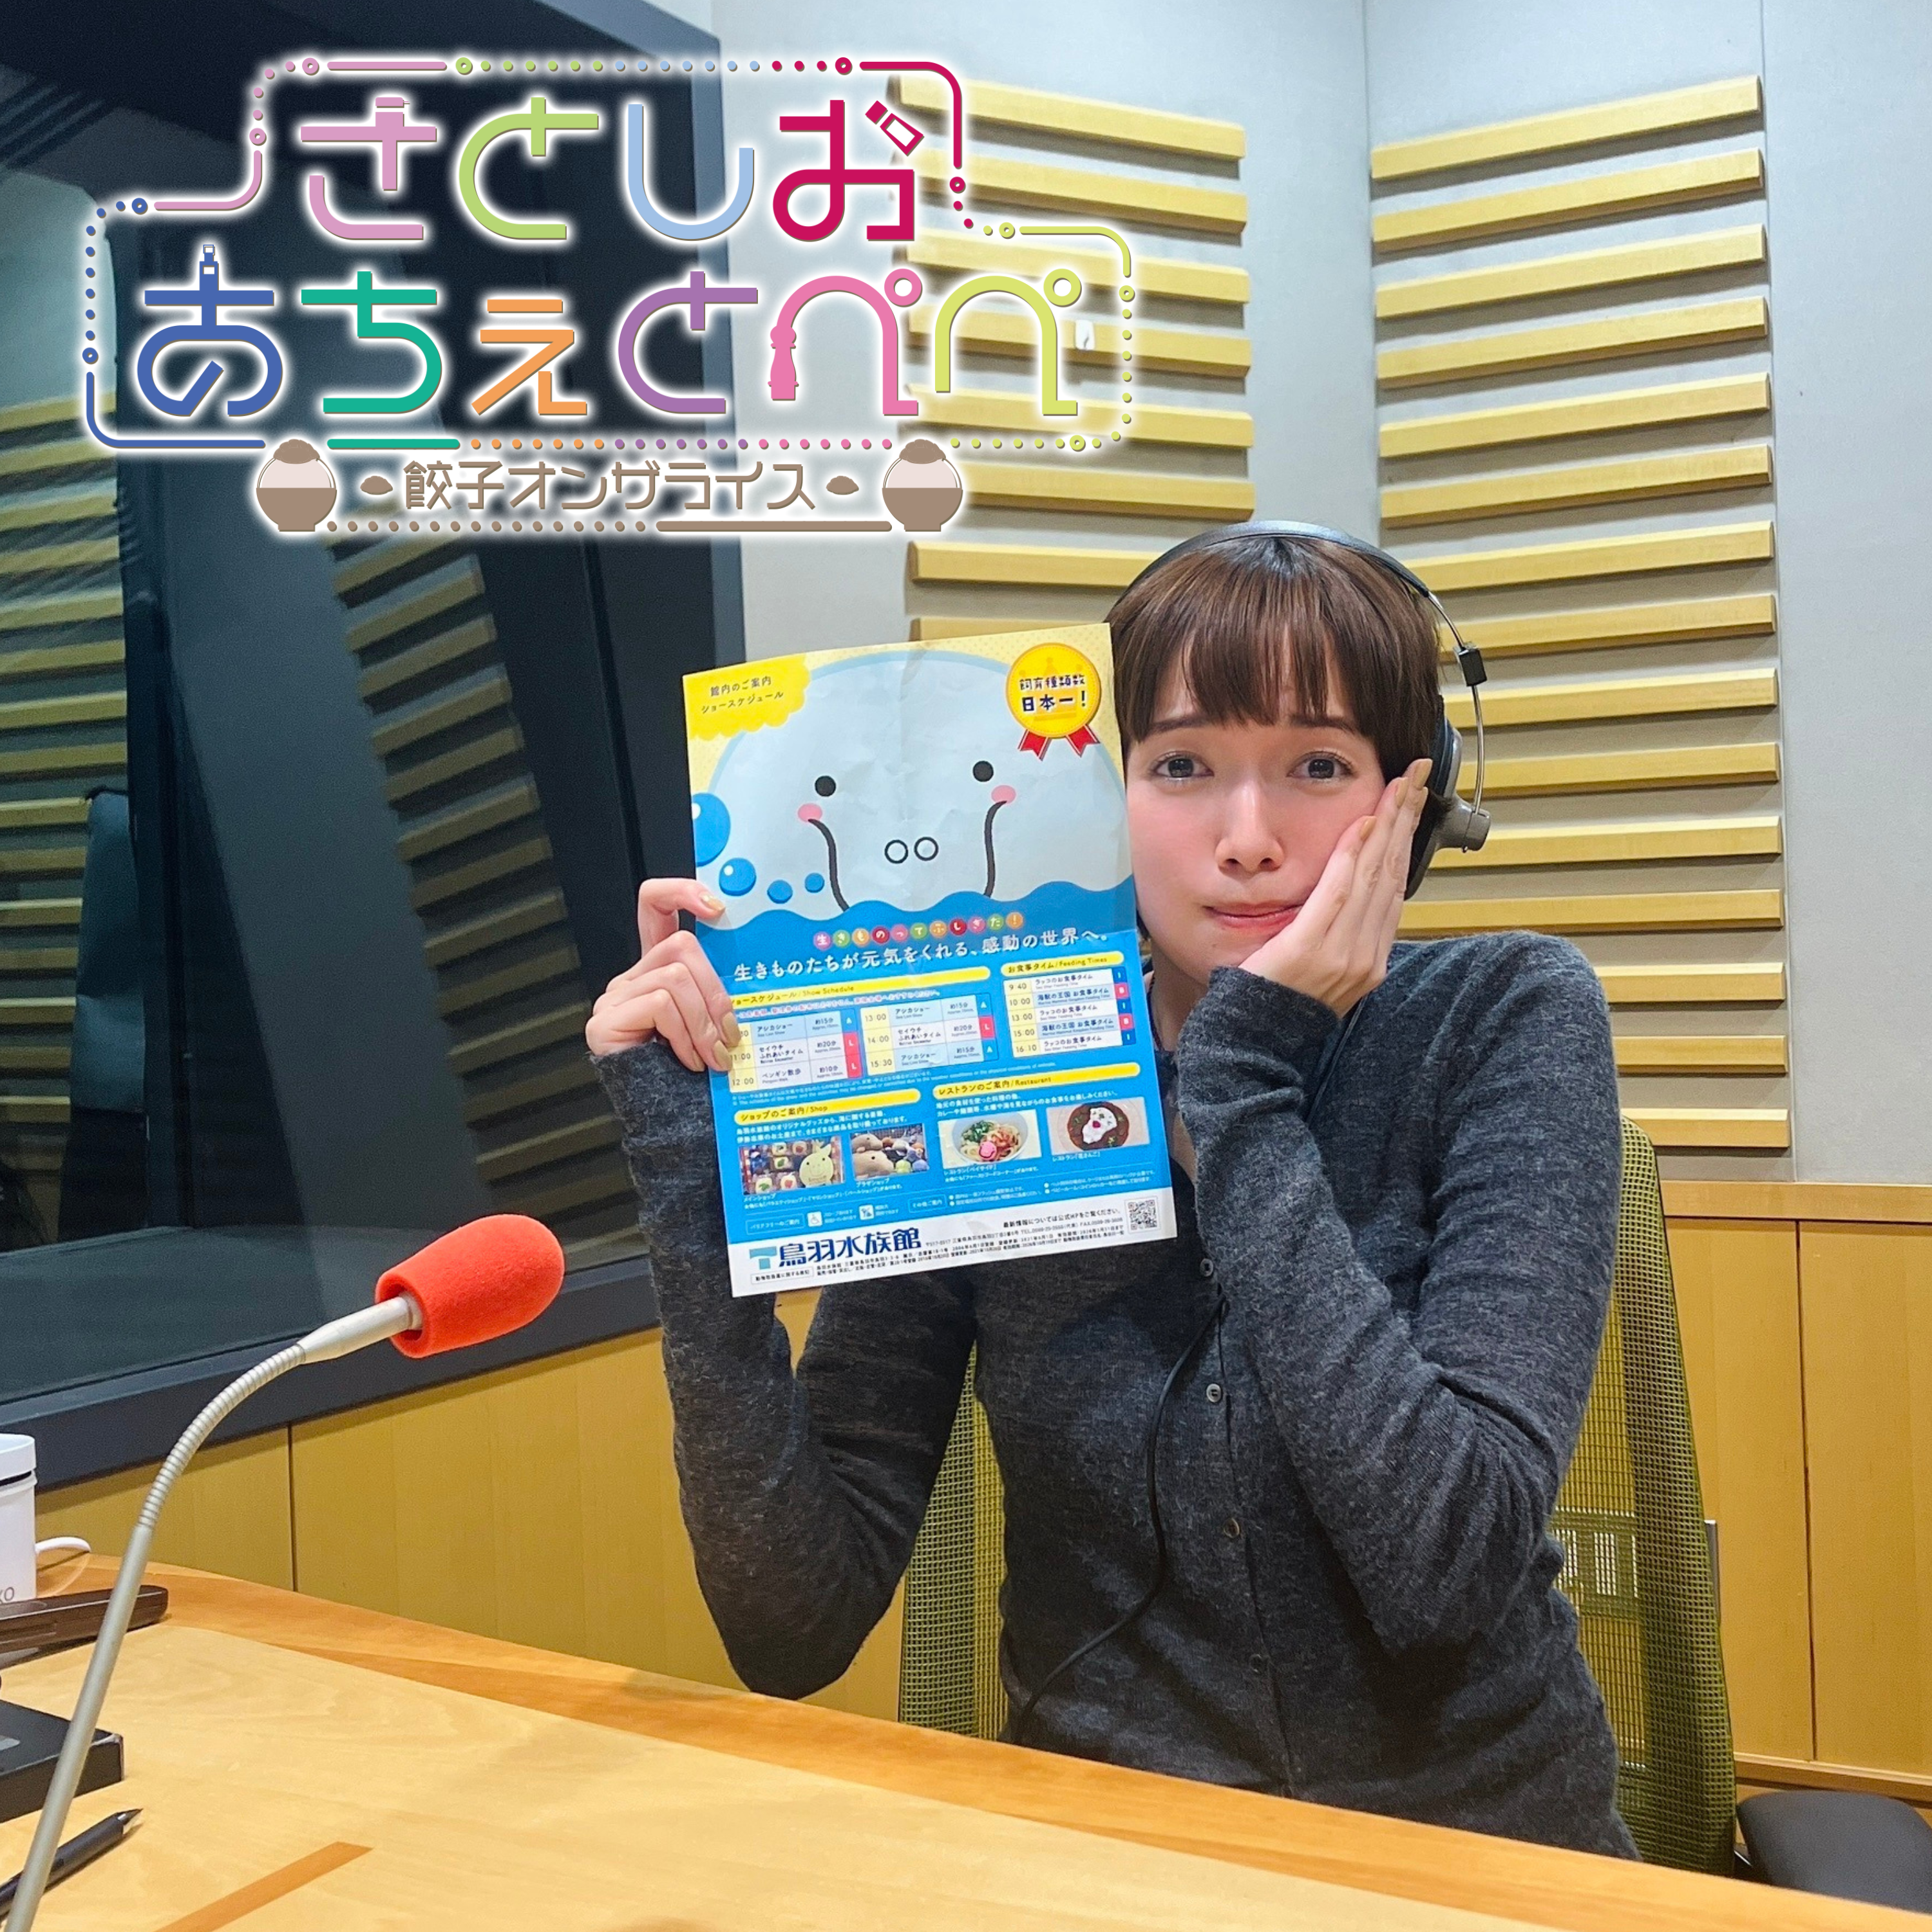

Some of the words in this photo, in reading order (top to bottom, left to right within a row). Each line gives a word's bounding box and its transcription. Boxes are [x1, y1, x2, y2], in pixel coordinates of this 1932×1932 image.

[710, 676, 772, 697] 館内のご案内
[1019, 674, 1085, 690] 飼育種類数
[701, 691, 784, 714] ショースケジュール
[734, 927, 1108, 981] 生きものたちが元気をくれる、感動の世界へ。
[1087, 956, 1107, 965] Times
[1034, 973, 1094, 986] ラッコのお食事タイム
[822, 985, 854, 995] Schedule
[1036, 990, 1071, 1001] 海獣の王国
[1072, 986, 1109, 998] お食事タイム
[895, 1005, 930, 1015] アシカショー
[1039, 1004, 1097, 1017] ラッコのお食事タイム
[814, 1016, 834, 1025] 約15分
[983, 1022, 990, 1030] L
[1041, 1021, 1075, 1033] 海獣の王国
[1077, 1017, 1114, 1028] お食事タイム
[756, 1022, 793, 1033] アシカショー
[897, 1026, 922, 1035] セイウチ
[897, 1030, 941, 1042] ふれあいタイム
[1043, 1035, 1102, 1048] ラッコのお食事タイム
[759, 1043, 784, 1052] セイウチ
[816, 1039, 836, 1048] 約20分
[986, 1045, 993, 1054] A
[759, 1047, 803, 1059] ふれあいタイム
[900, 1050, 936, 1061] アシカショー
[761, 1067, 801, 1079] ペンギン散歩
[819, 1065, 838, 1074] 約10分
[777, 1226, 922, 1267] 鳥羽水族館
